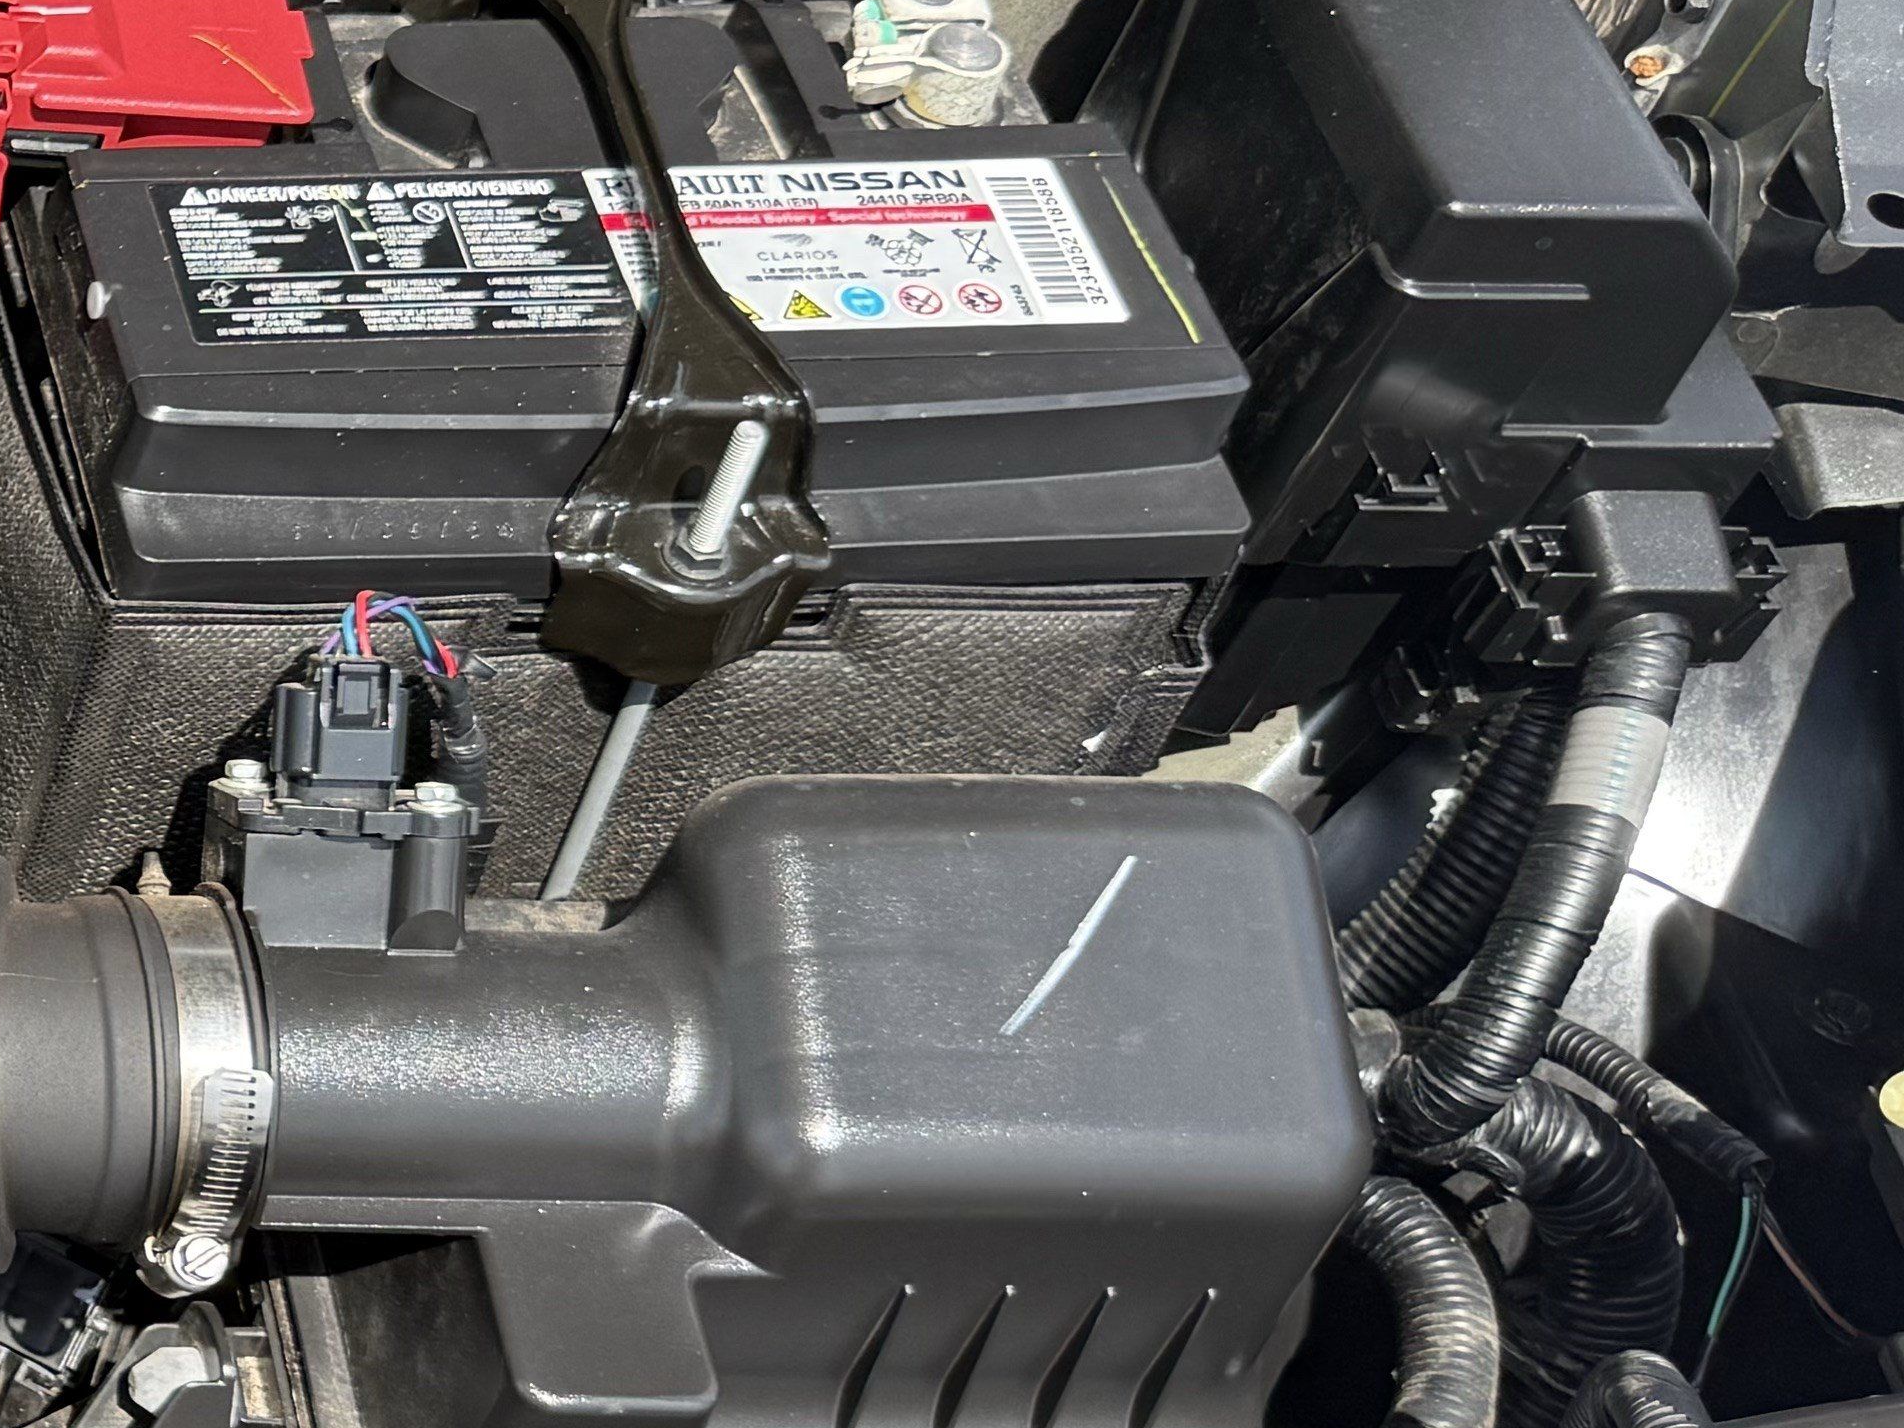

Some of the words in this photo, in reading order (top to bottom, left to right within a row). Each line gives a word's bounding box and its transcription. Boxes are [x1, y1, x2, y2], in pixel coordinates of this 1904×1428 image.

[776, 169, 967, 193] NISSAN
[745, 199, 782, 209] 510A
[856, 193, 908, 206] 24410
[756, 250, 839, 262] CLARIOS
